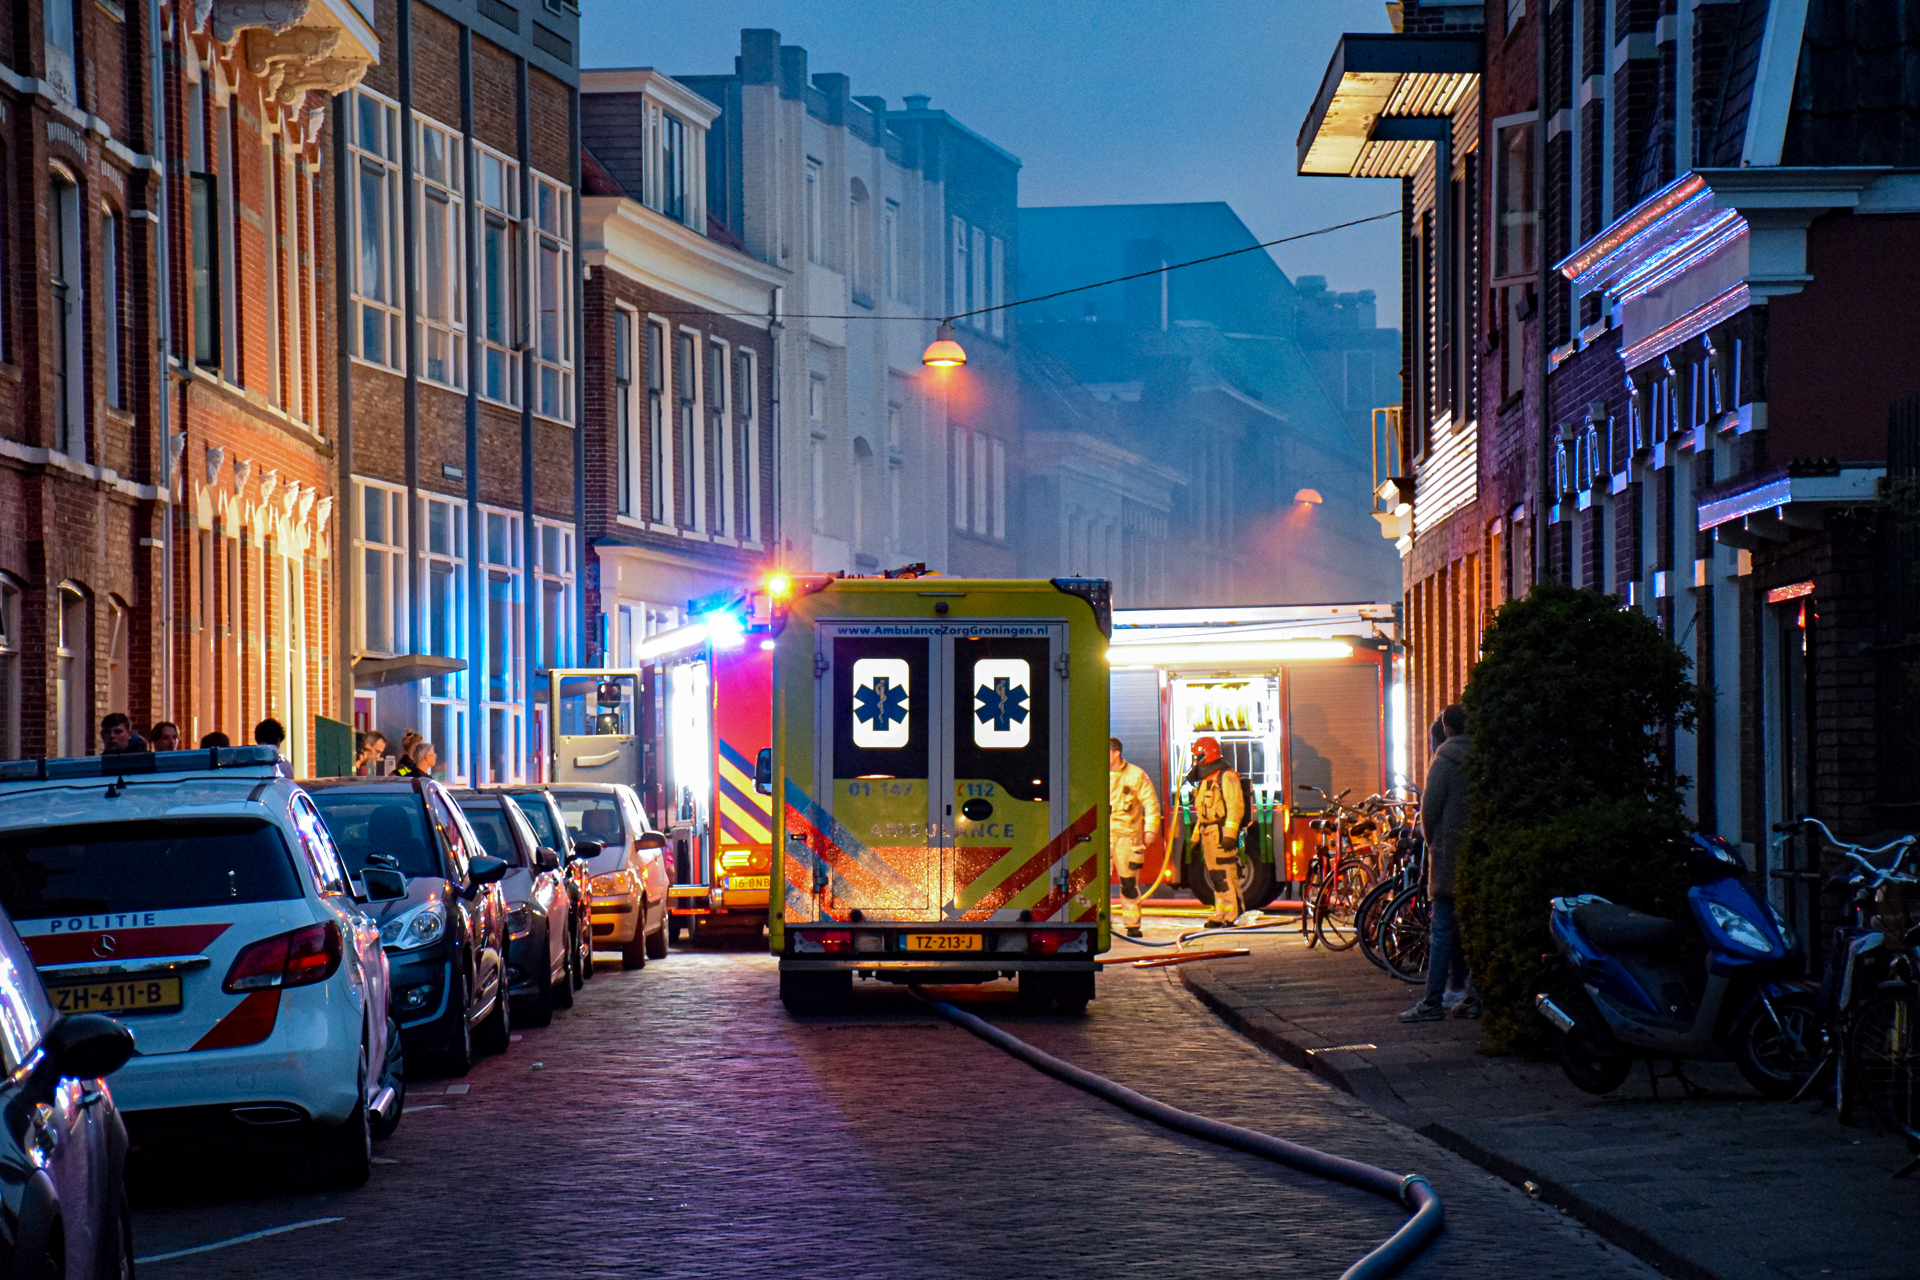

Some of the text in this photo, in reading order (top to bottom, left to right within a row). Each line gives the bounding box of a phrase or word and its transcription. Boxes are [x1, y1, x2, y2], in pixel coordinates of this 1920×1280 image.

[837, 626, 1049, 637] www.AmbulanceZorgGroningen.nl
[869, 822, 1015, 839] AMBULANCE
[51, 912, 156, 934] POLITIE
[915, 935, 973, 949] TZ-213-J
[57, 982, 162, 1011] ZH-411-B
